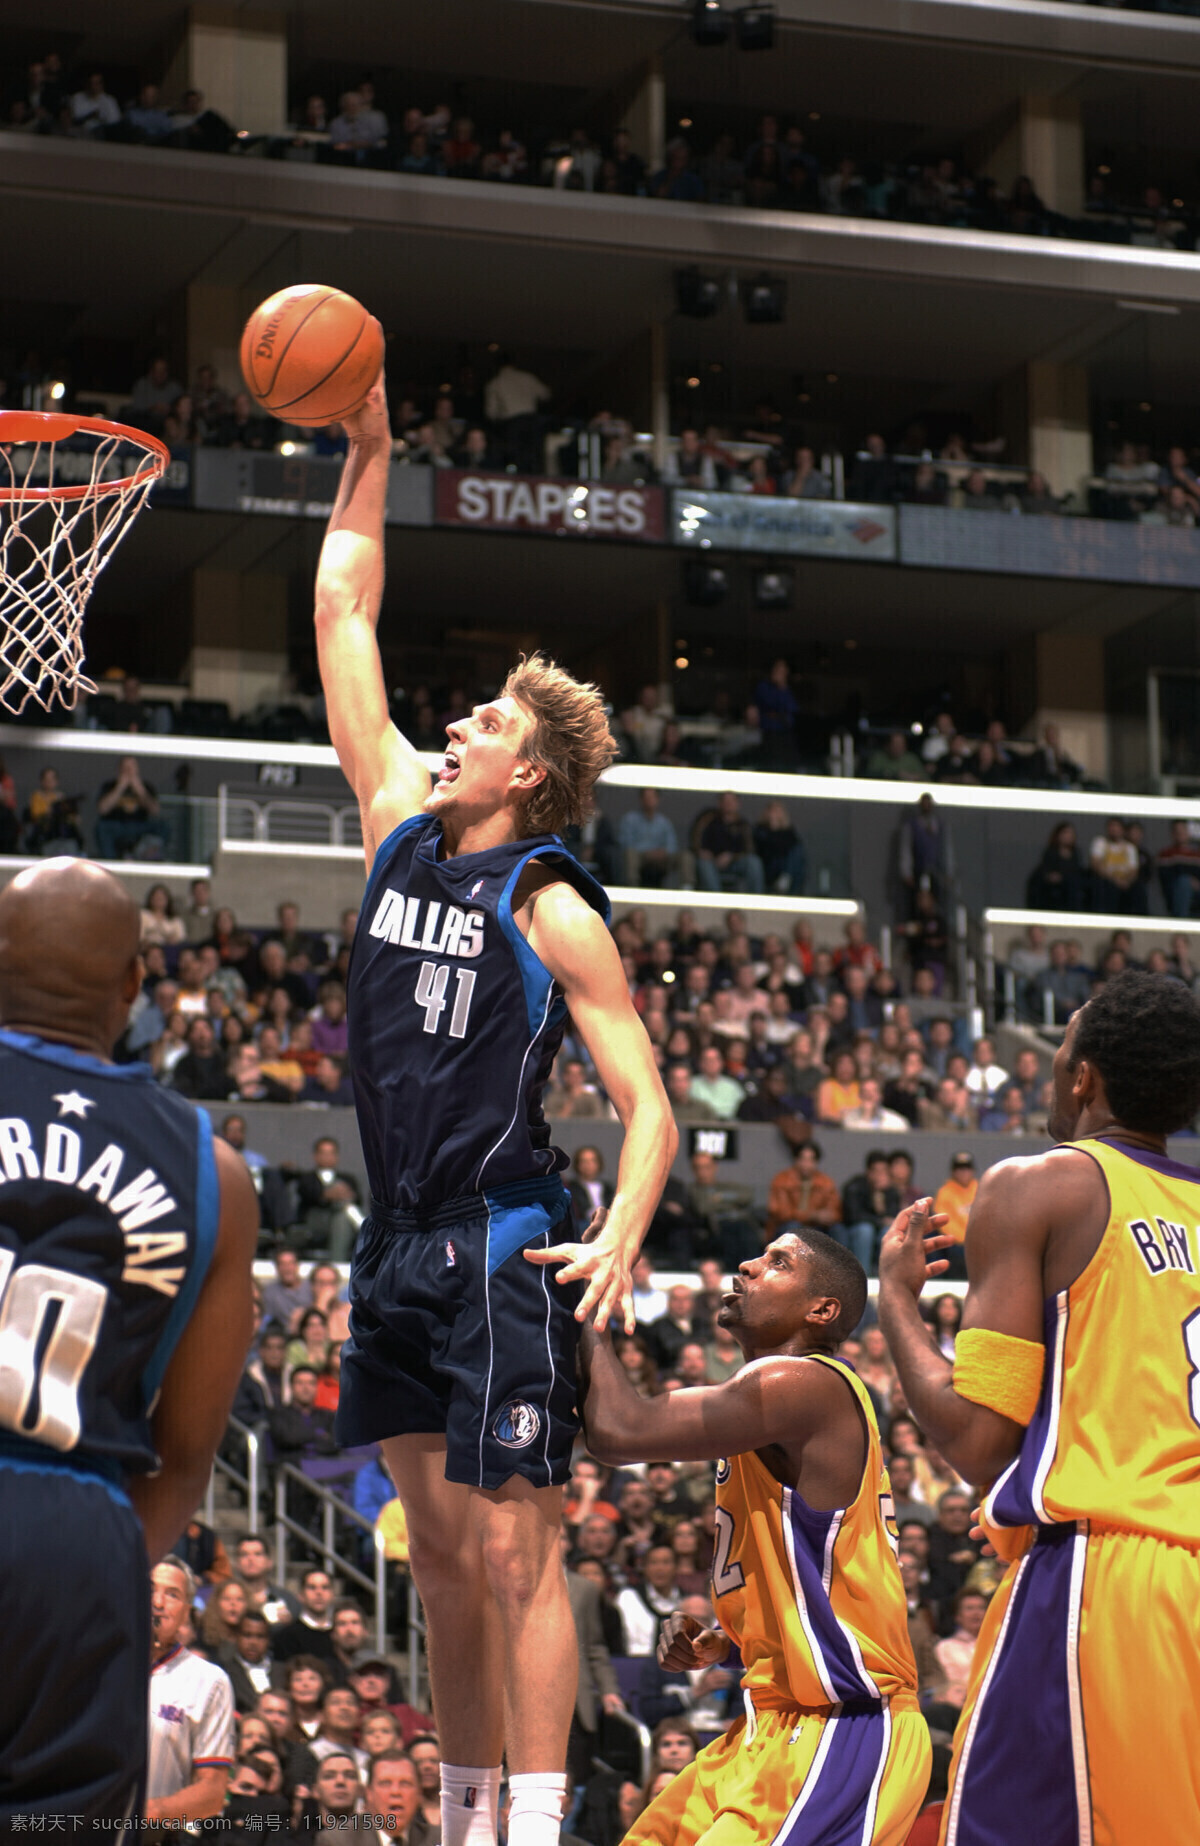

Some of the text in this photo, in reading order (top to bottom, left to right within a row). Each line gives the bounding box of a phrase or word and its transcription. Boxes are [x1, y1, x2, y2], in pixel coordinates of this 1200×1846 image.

[457, 476, 645, 533] STAPLES
[369, 888, 486, 959] DALLAS
[414, 961, 478, 1039] 41
[0, 1118, 187, 1298] RDAWAY
[1128, 1214, 1200, 1277] BRY
